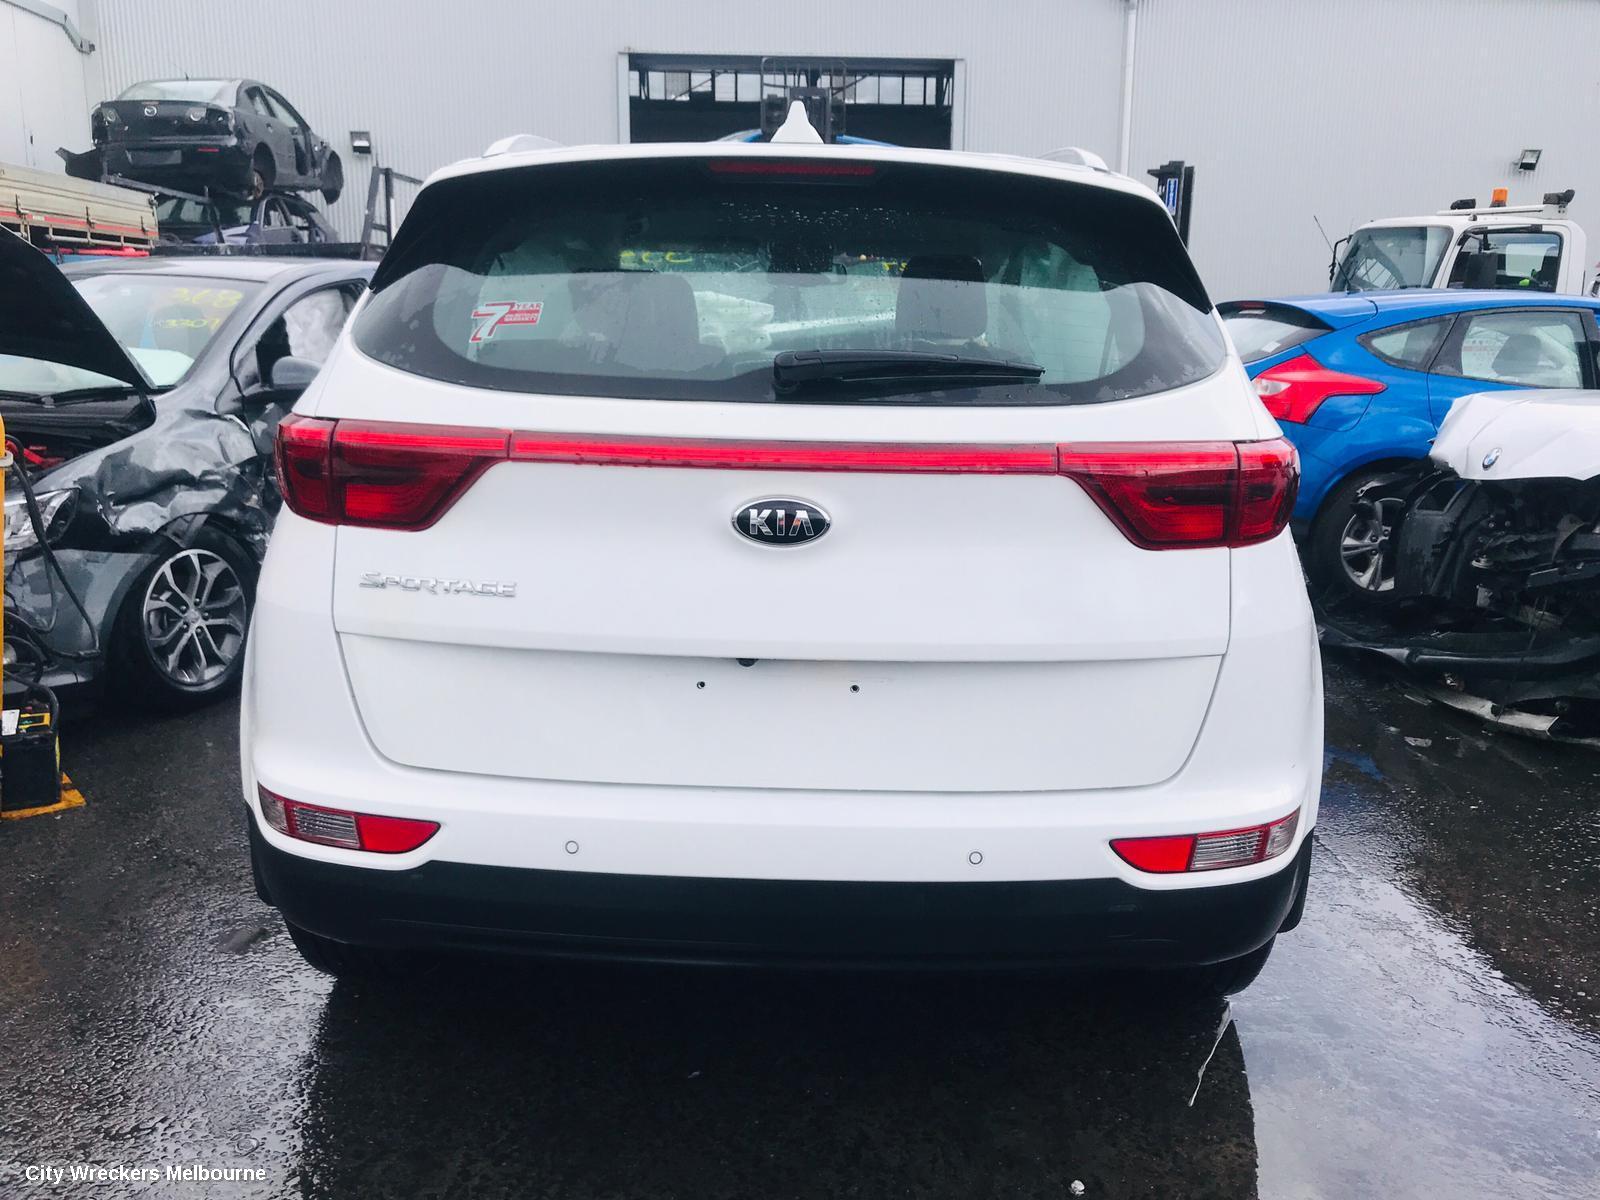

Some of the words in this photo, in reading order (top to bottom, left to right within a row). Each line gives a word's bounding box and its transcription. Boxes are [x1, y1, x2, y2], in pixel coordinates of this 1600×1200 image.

[470, 302, 516, 342] 7
[515, 302, 542, 311] YEAR
[749, 508, 815, 536] KIA
[359, 571, 517, 598] SPORTAGE
